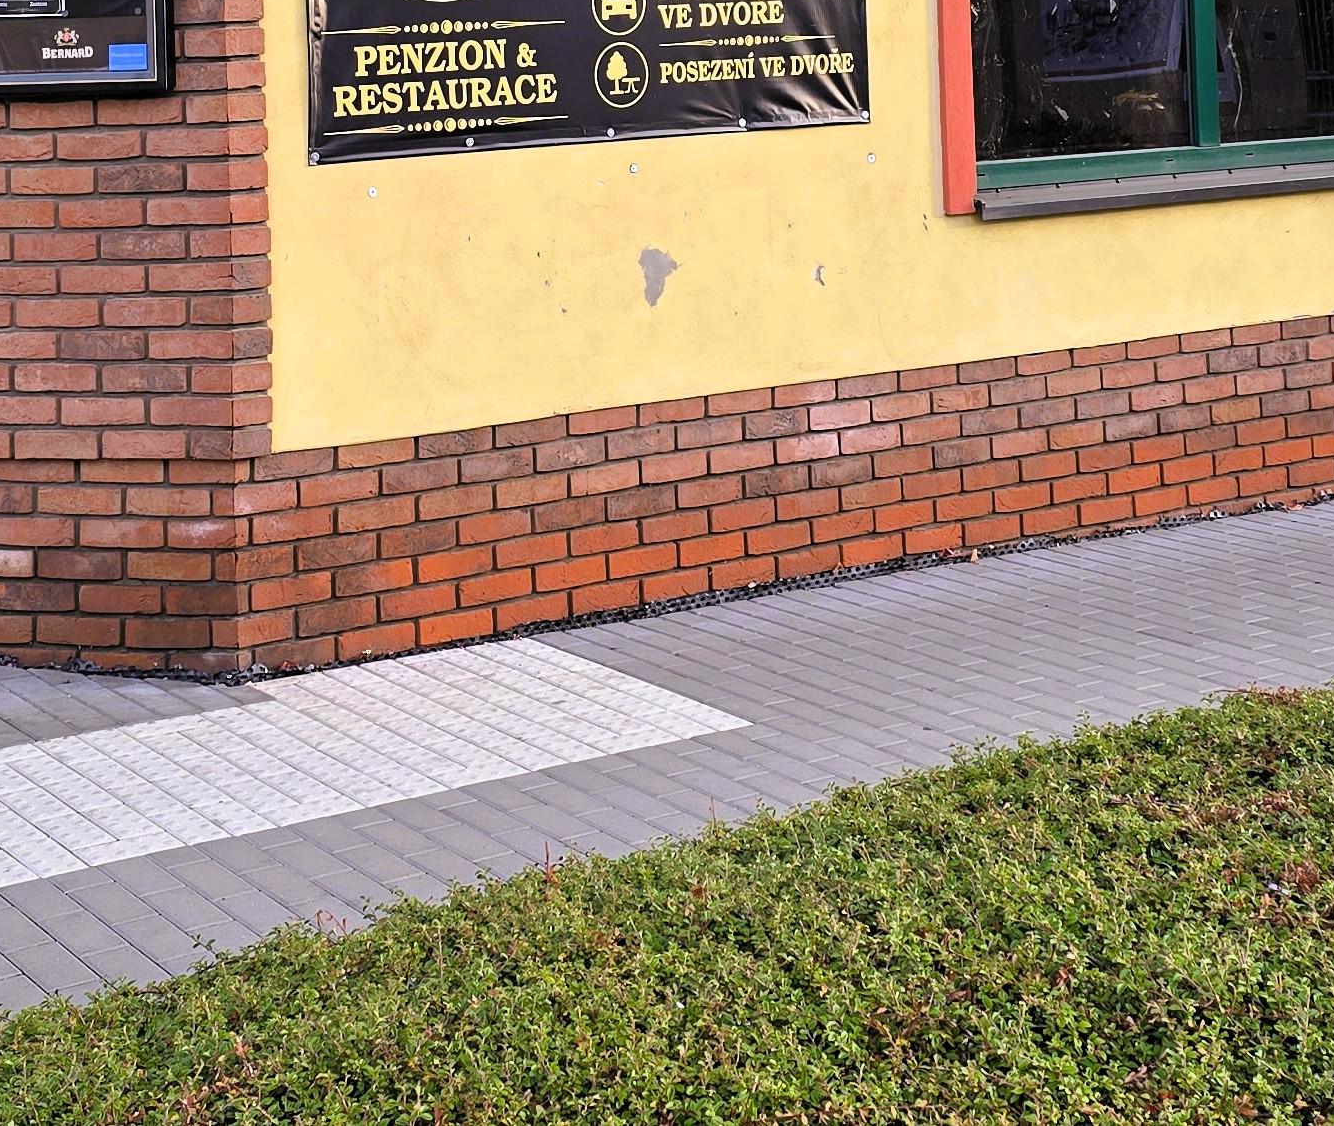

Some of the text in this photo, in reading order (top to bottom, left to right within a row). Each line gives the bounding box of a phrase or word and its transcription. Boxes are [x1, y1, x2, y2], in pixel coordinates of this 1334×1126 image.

[657, 4, 693, 29] VE
[42, 46, 94, 60] BERNARD
[353, 38, 538, 77] PENZION &
[660, 47, 855, 84] POSEZENÍ VE DVOŘE
[332, 73, 558, 117] RESTAURACE
